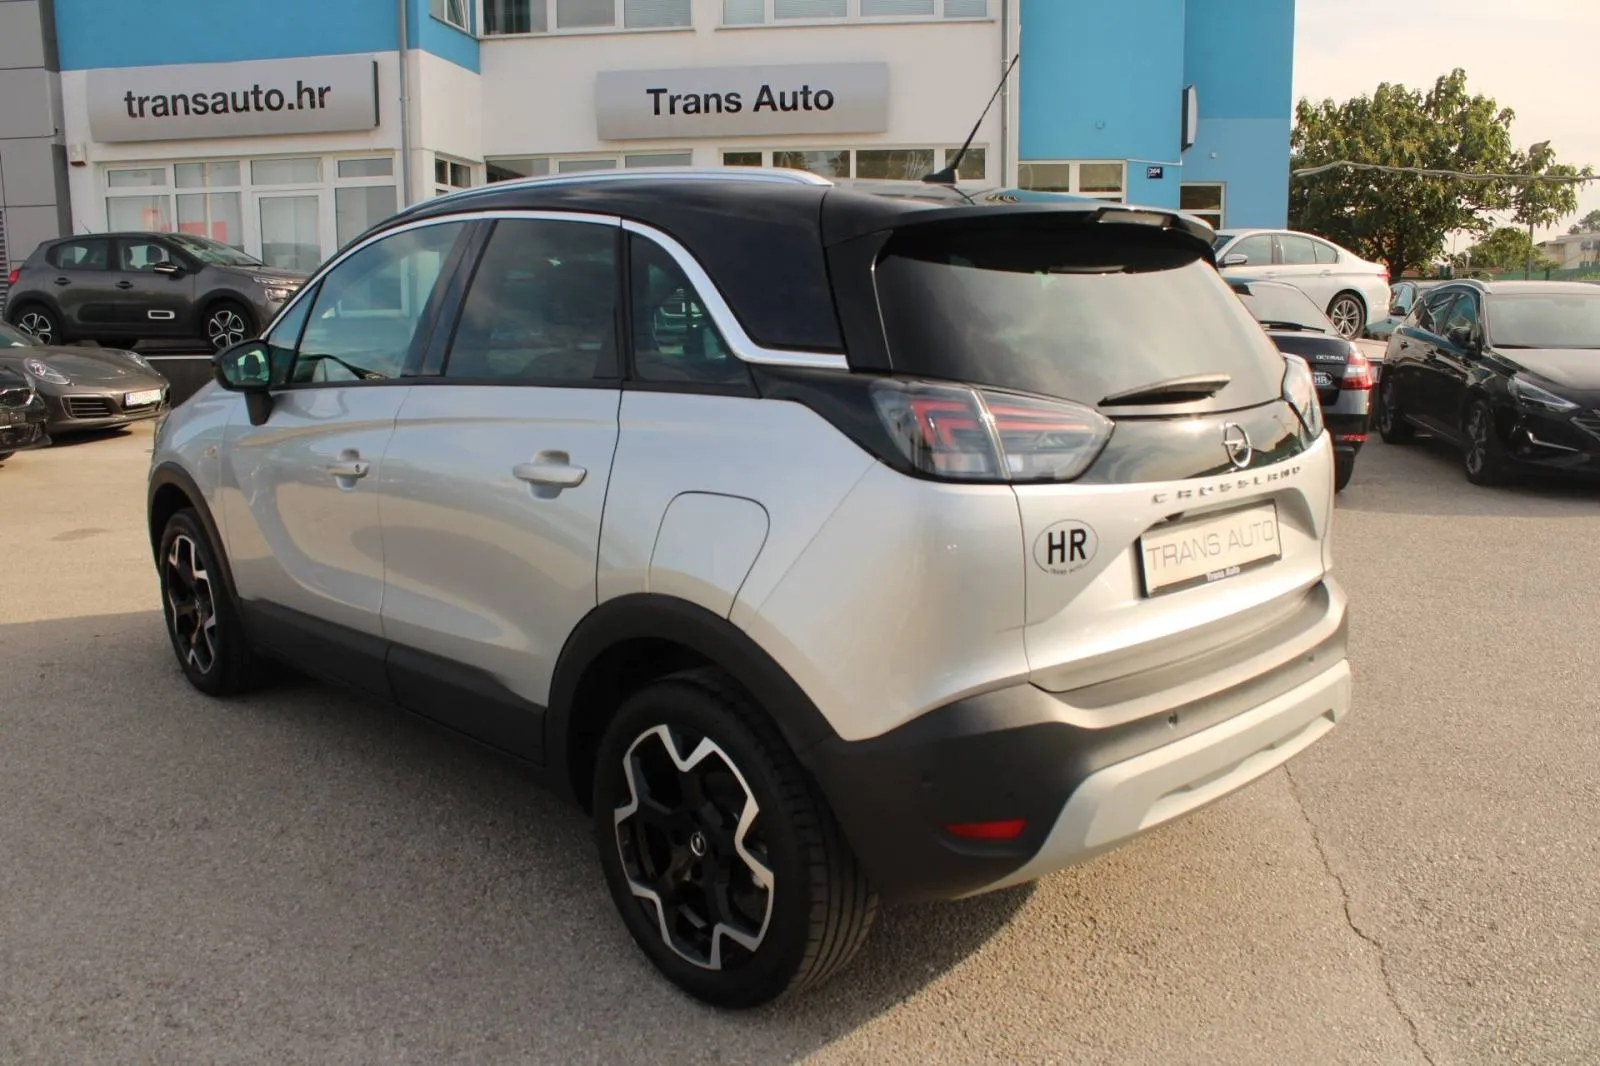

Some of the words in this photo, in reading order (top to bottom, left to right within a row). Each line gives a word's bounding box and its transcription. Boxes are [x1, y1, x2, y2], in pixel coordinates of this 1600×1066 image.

[124, 80, 331, 118] transauto.hr
[646, 88, 742, 116] Trans
[752, 84, 835, 112] Auto
[1047, 528, 1087, 565] HR
[1146, 533, 1221, 571] TRANS
[1227, 520, 1275, 548] AUTO
